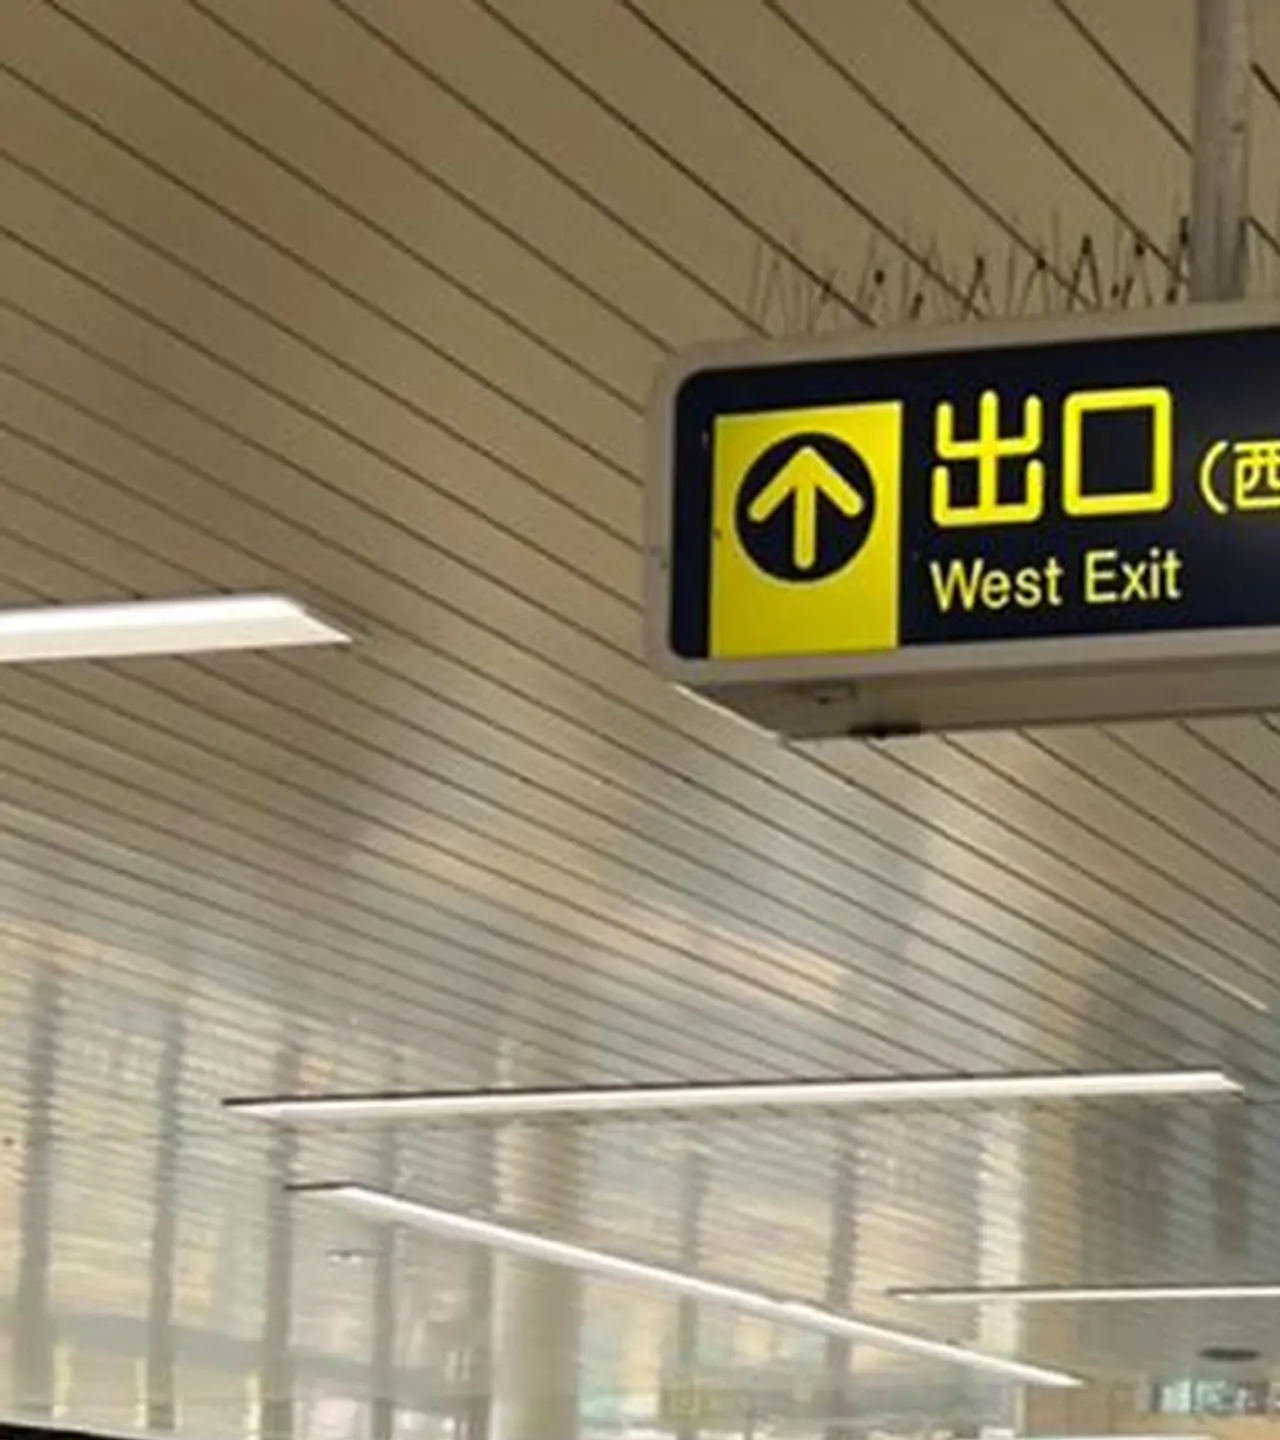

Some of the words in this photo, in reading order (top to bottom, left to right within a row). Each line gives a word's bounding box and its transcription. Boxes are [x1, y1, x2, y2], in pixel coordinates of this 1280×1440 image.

[931, 387, 1174, 529] 出口
[930, 557, 1064, 613] West
[1085, 548, 1183, 605] Exit
